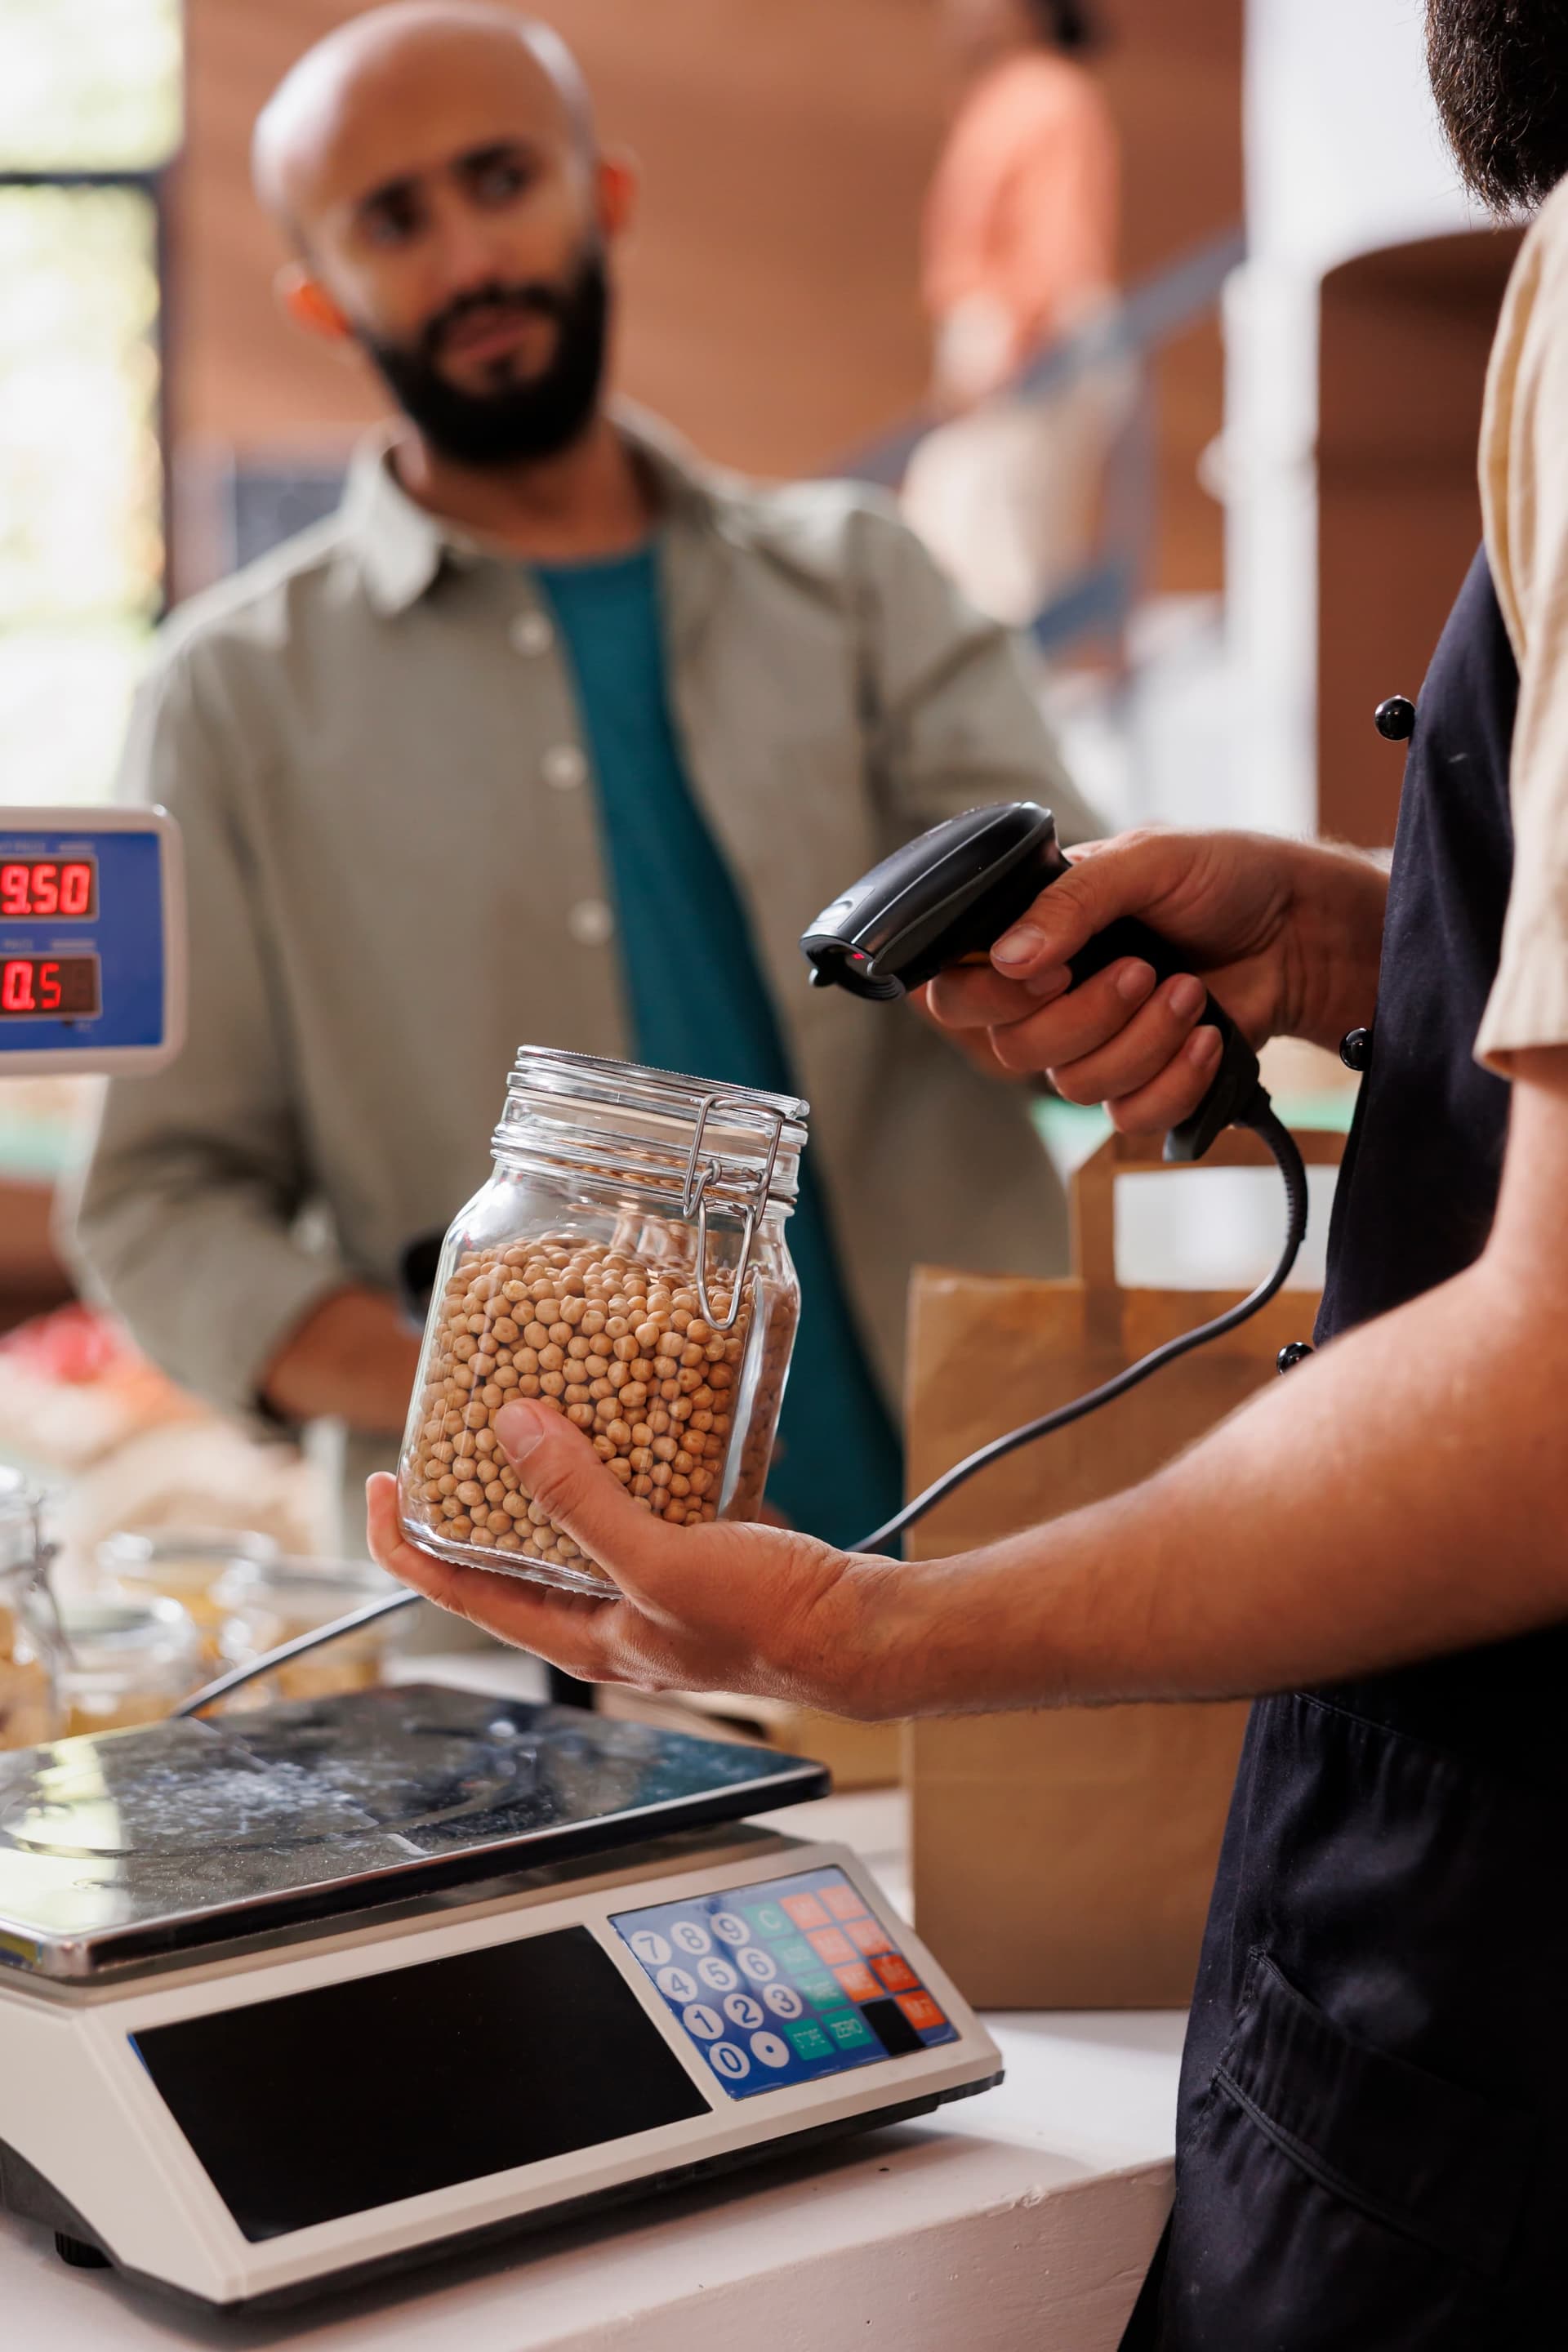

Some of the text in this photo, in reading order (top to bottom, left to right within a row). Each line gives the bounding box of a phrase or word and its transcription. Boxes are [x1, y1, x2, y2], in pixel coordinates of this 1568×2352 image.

[0, 864, 91, 915] 9.50
[2, 960, 61, 1009] 0.5
[638, 1936, 658, 1959] 7
[680, 1927, 704, 1949] 8
[719, 1918, 742, 1940] 9
[759, 1909, 782, 1930] C
[670, 1972, 690, 1994] 4
[706, 1962, 730, 1985] 5
[746, 1953, 769, 1976] 6
[694, 2010, 715, 2033] 1
[733, 1999, 759, 2023] 2
[771, 1989, 795, 2012] 3
[719, 2047, 742, 2072] 0
[830, 2018, 863, 2038] ZERO
